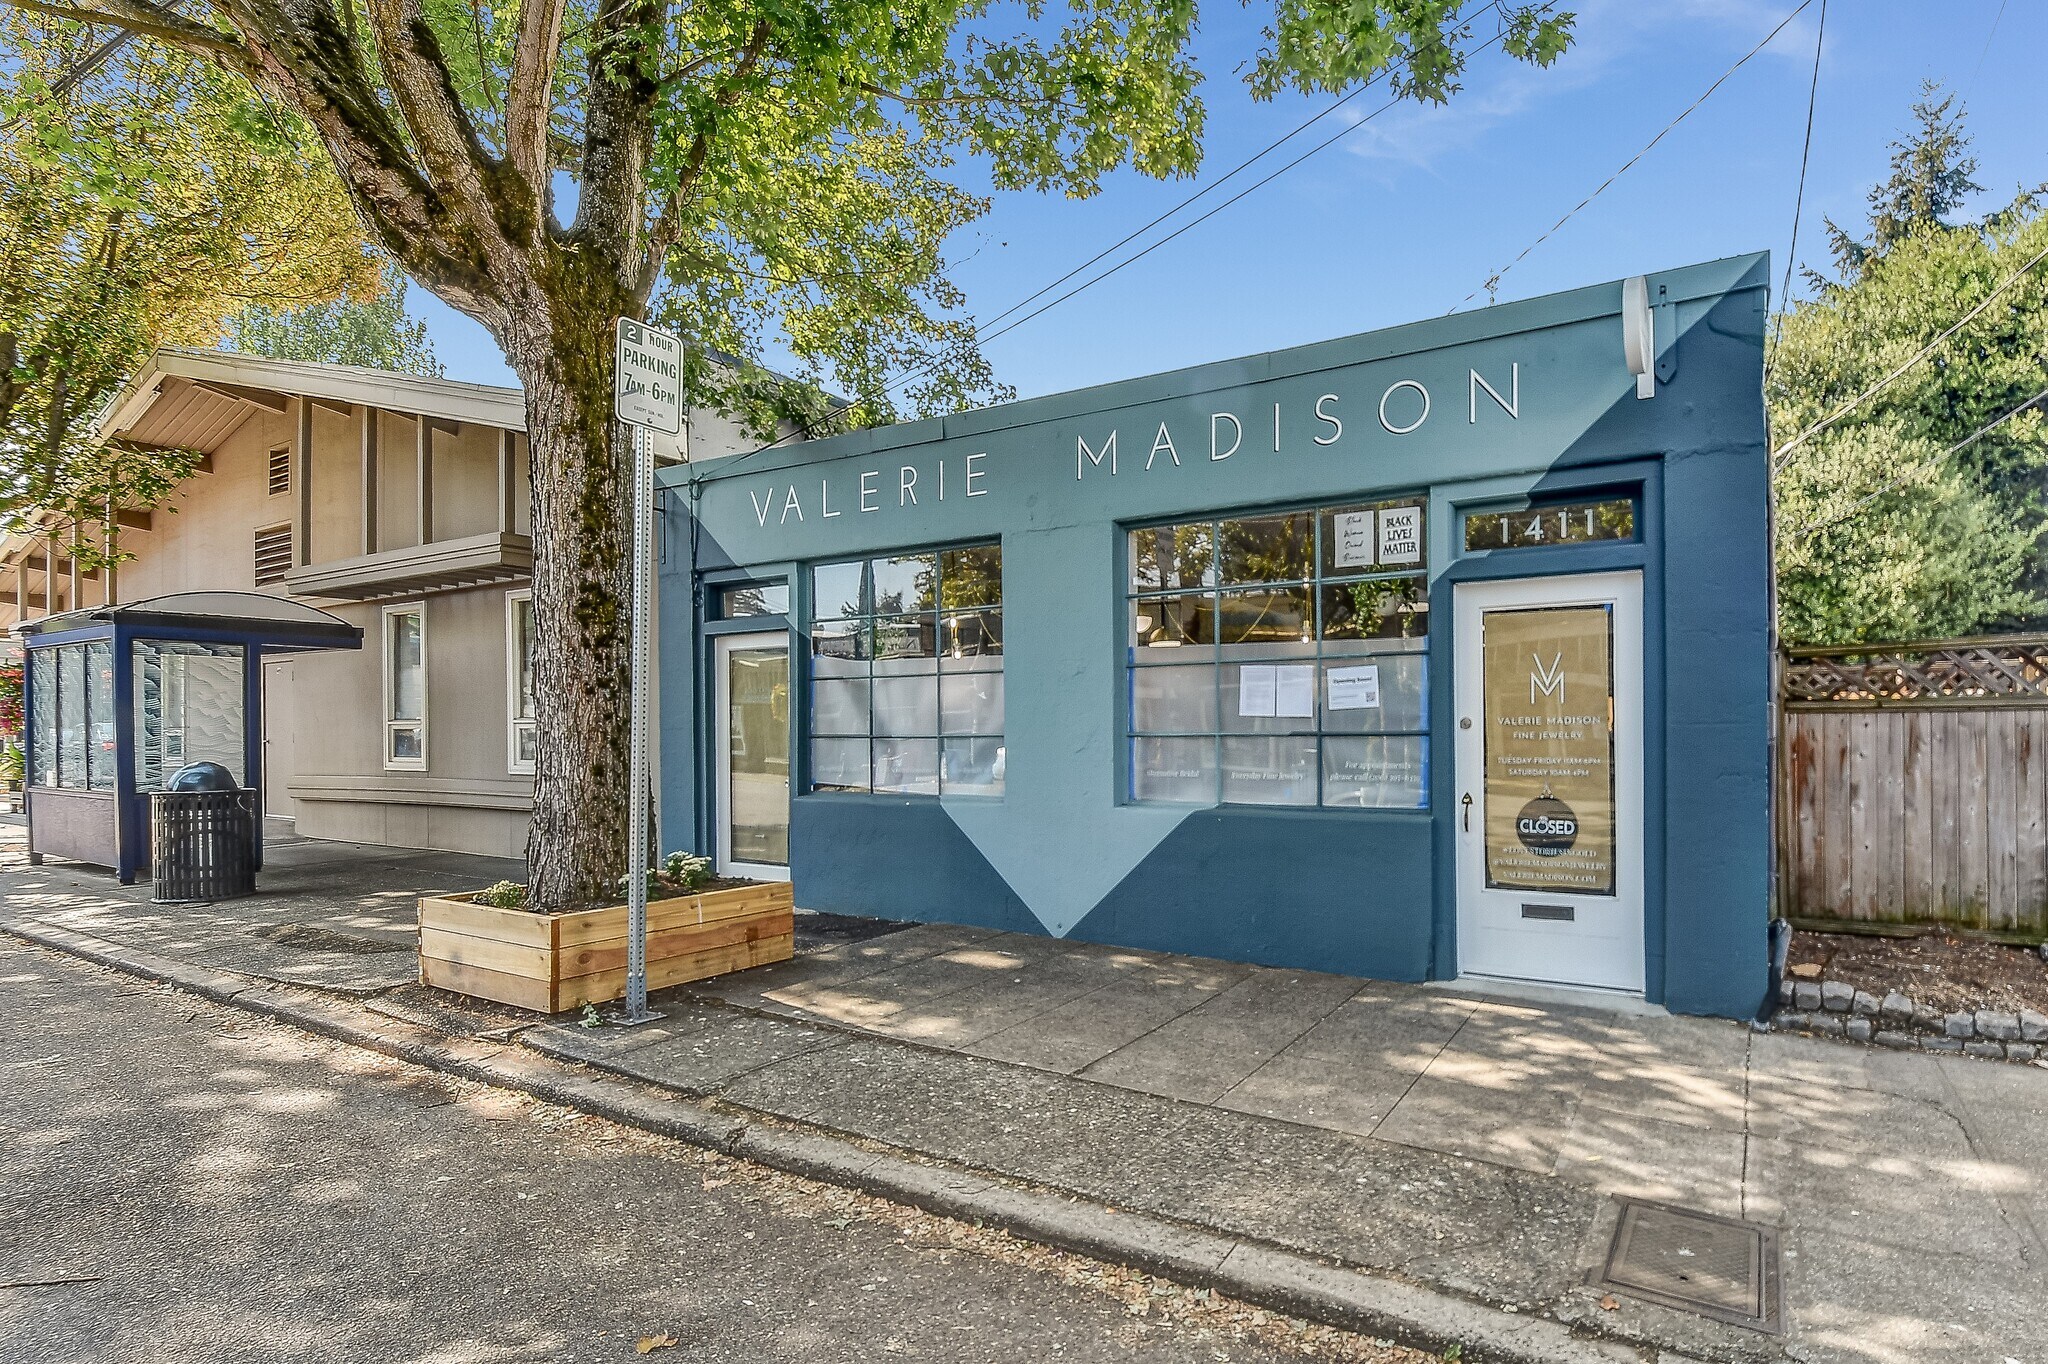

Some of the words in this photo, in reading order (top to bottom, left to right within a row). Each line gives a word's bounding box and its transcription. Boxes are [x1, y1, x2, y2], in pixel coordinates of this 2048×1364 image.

[626, 325, 637, 340] 2
[649, 333, 673, 353] HOUR
[623, 346, 677, 379] PARKING
[750, 452, 988, 528] VALERIE
[1076, 362, 1520, 480] MADISON
[1385, 515, 1412, 528] BLACK
[1499, 508, 1596, 544] 1411
[1387, 528, 1413, 541] LIVES
[1382, 541, 1417, 556] MATTER
[1497, 716, 1542, 726] VALERIE
[1546, 715, 1601, 726] MADISON
[1513, 731, 1536, 740] FINE
[1539, 730, 1584, 741] JEWELRY
[1519, 817, 1576, 835] CLOSED
